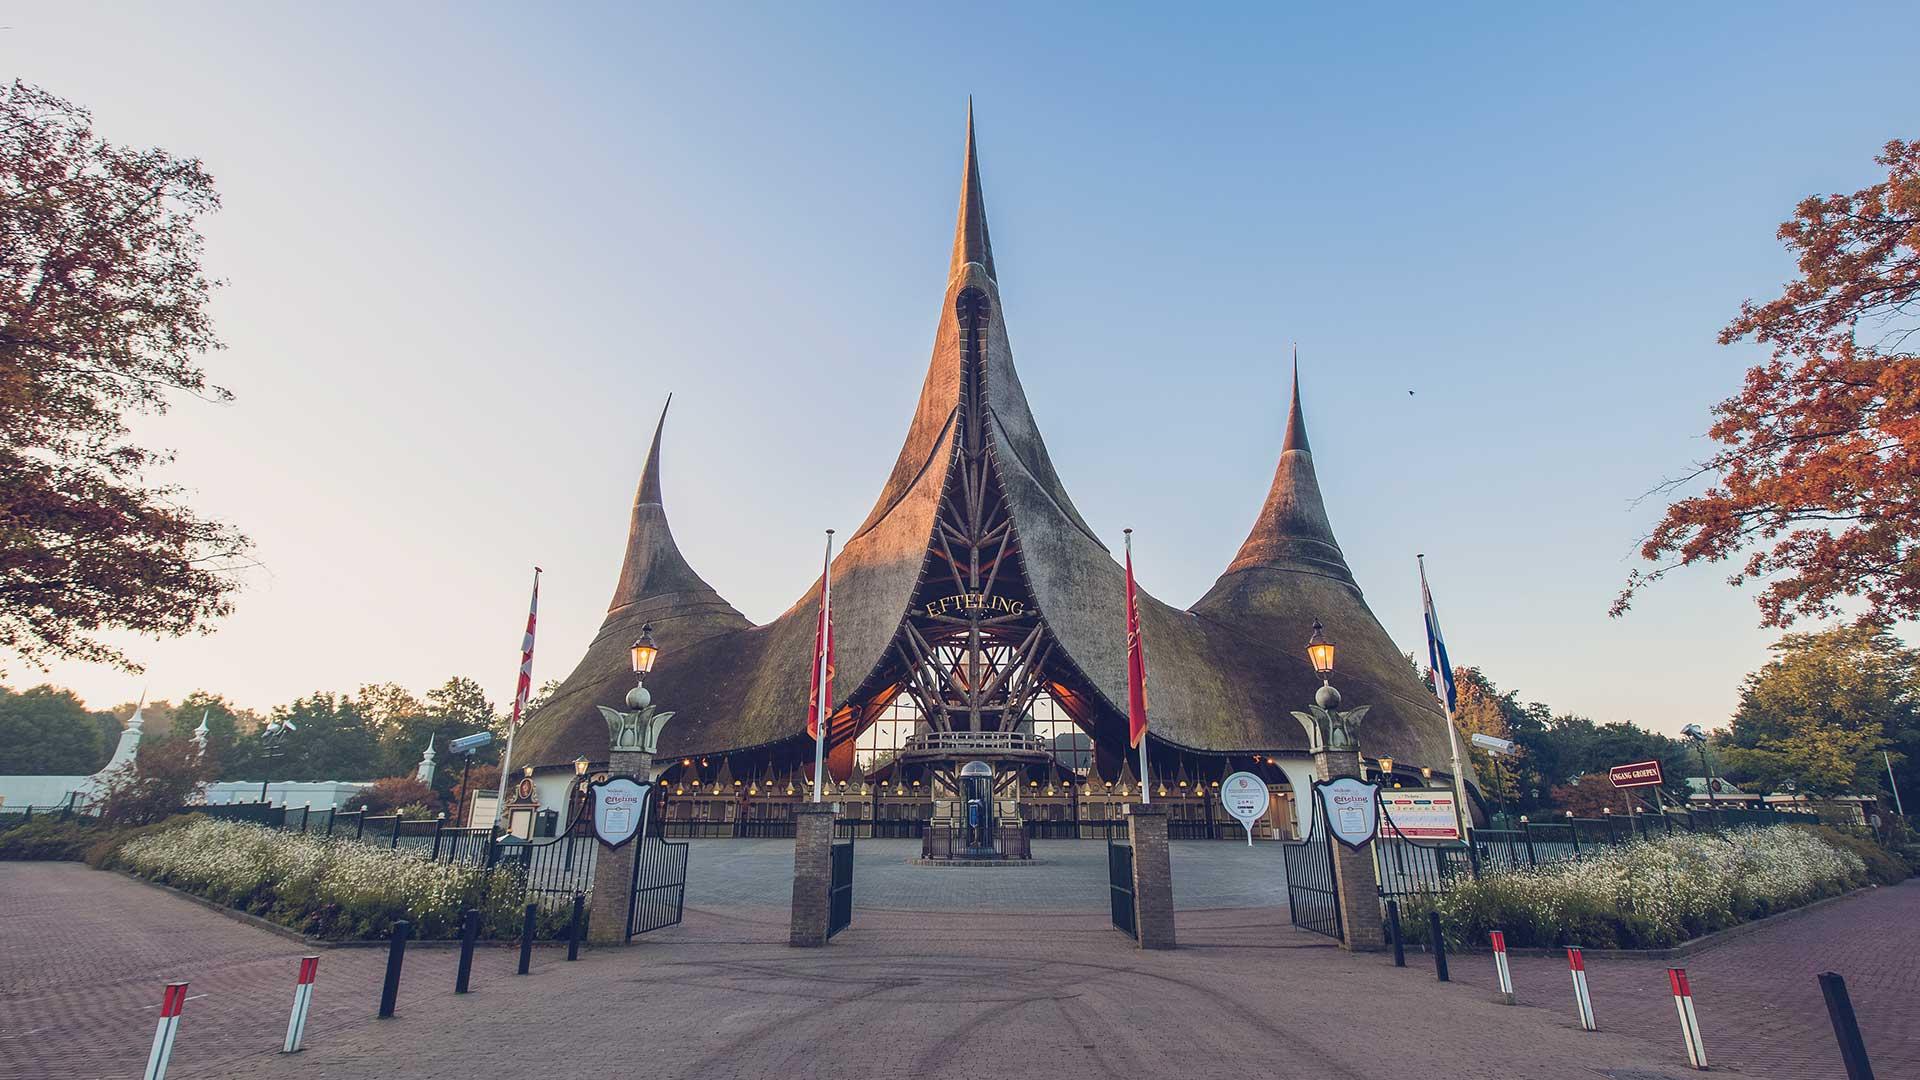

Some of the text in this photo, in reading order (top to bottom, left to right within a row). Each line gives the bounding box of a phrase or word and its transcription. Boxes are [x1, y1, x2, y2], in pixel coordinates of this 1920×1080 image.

[926, 593, 1024, 617] EFTELING
[1632, 768, 1657, 778] GROEPEN
[605, 795, 638, 805] Efteling
[1333, 795, 1369, 805] Efteling
